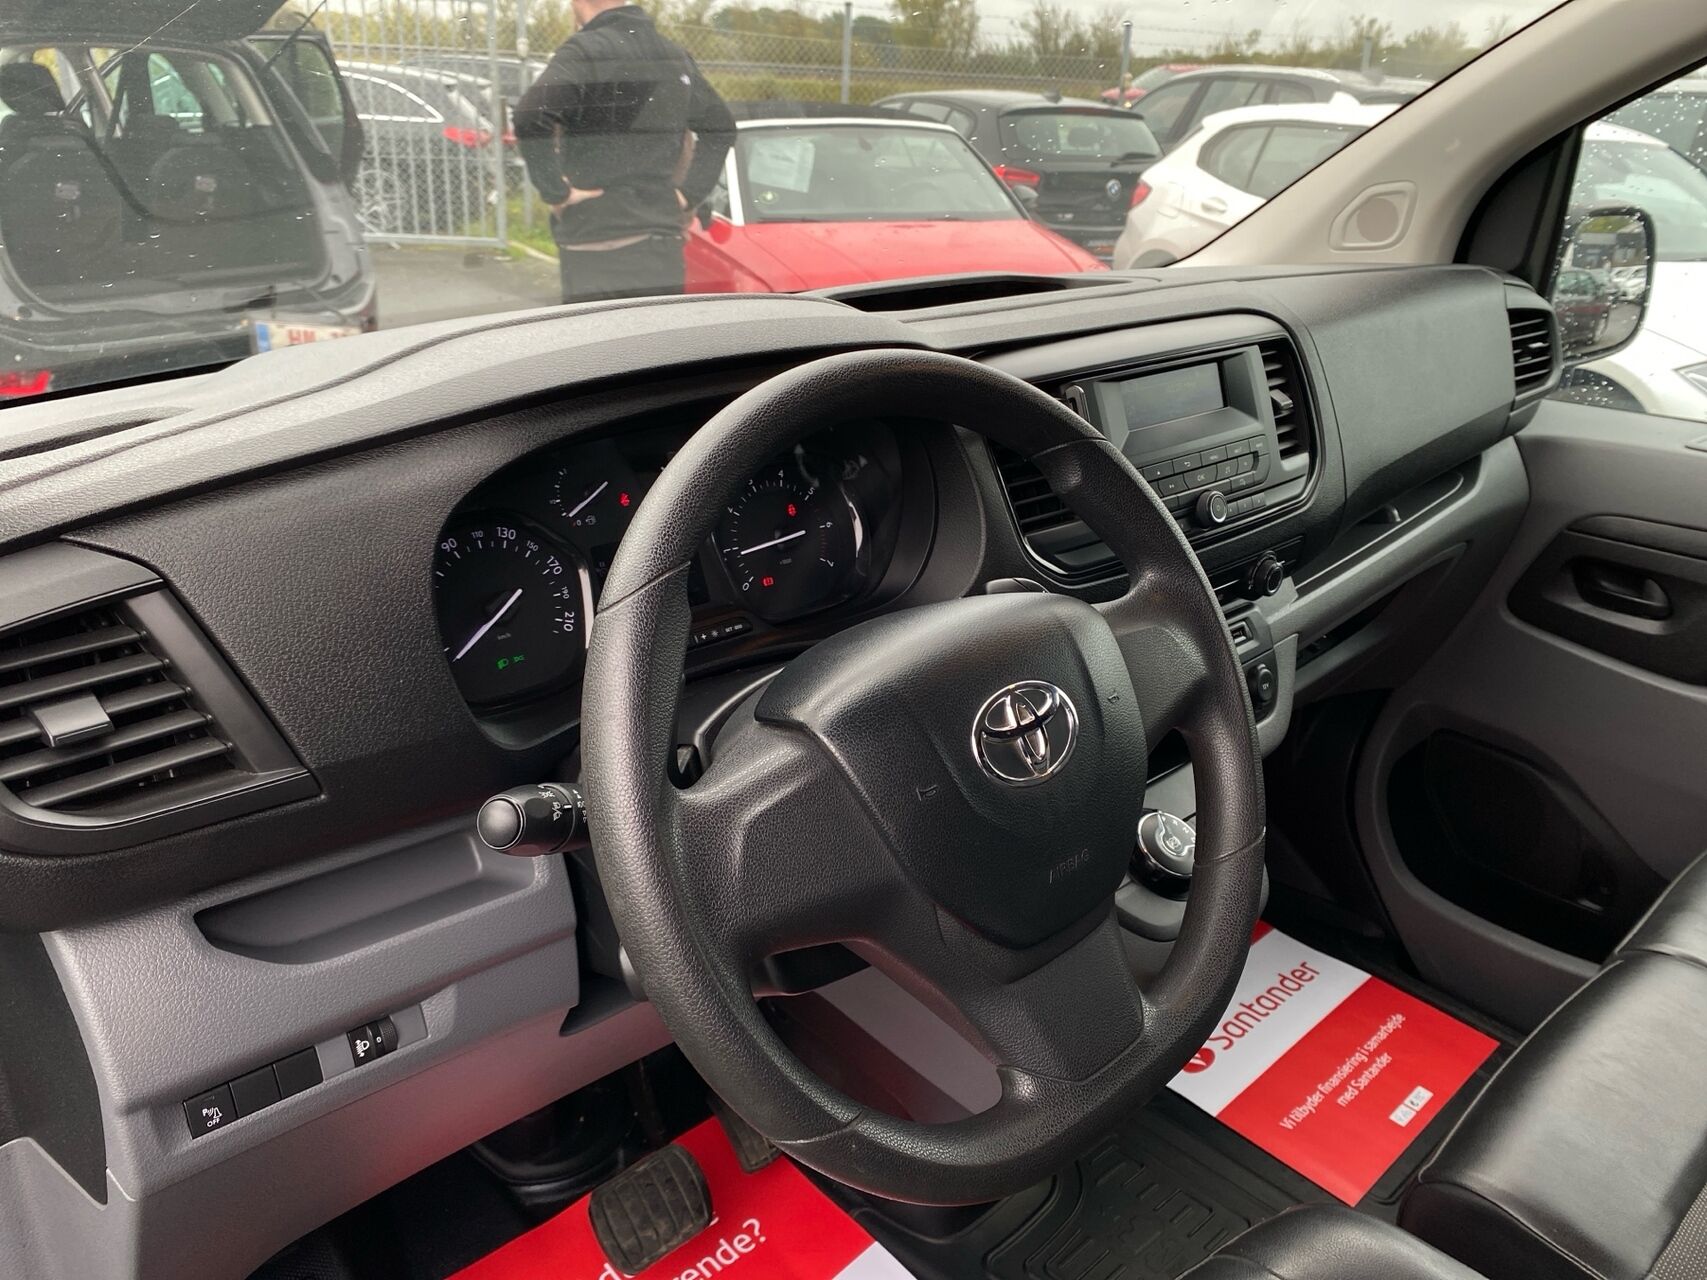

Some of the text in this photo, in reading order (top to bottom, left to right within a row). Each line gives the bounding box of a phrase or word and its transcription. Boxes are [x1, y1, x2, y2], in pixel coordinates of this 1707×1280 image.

[471, 529, 484, 539] 110
[496, 527, 517, 540] 130
[441, 537, 458, 552] 90
[526, 540, 539, 552] 150
[546, 555, 563, 576] 170
[561, 586, 570, 599] 190
[563, 611, 575, 632] 210
[1208, 961, 1321, 1050] Santander
[1278, 1114, 1295, 1131] Vi
[1289, 1086, 1325, 1123] tilbyder
[1317, 1050, 1368, 1096] finansiering
[1363, 1012, 1406, 1056] samarbejde
[1336, 1082, 1359, 1108] med
[1350, 1051, 1394, 1092] Santander
[206, 1117, 220, 1128] OFF
